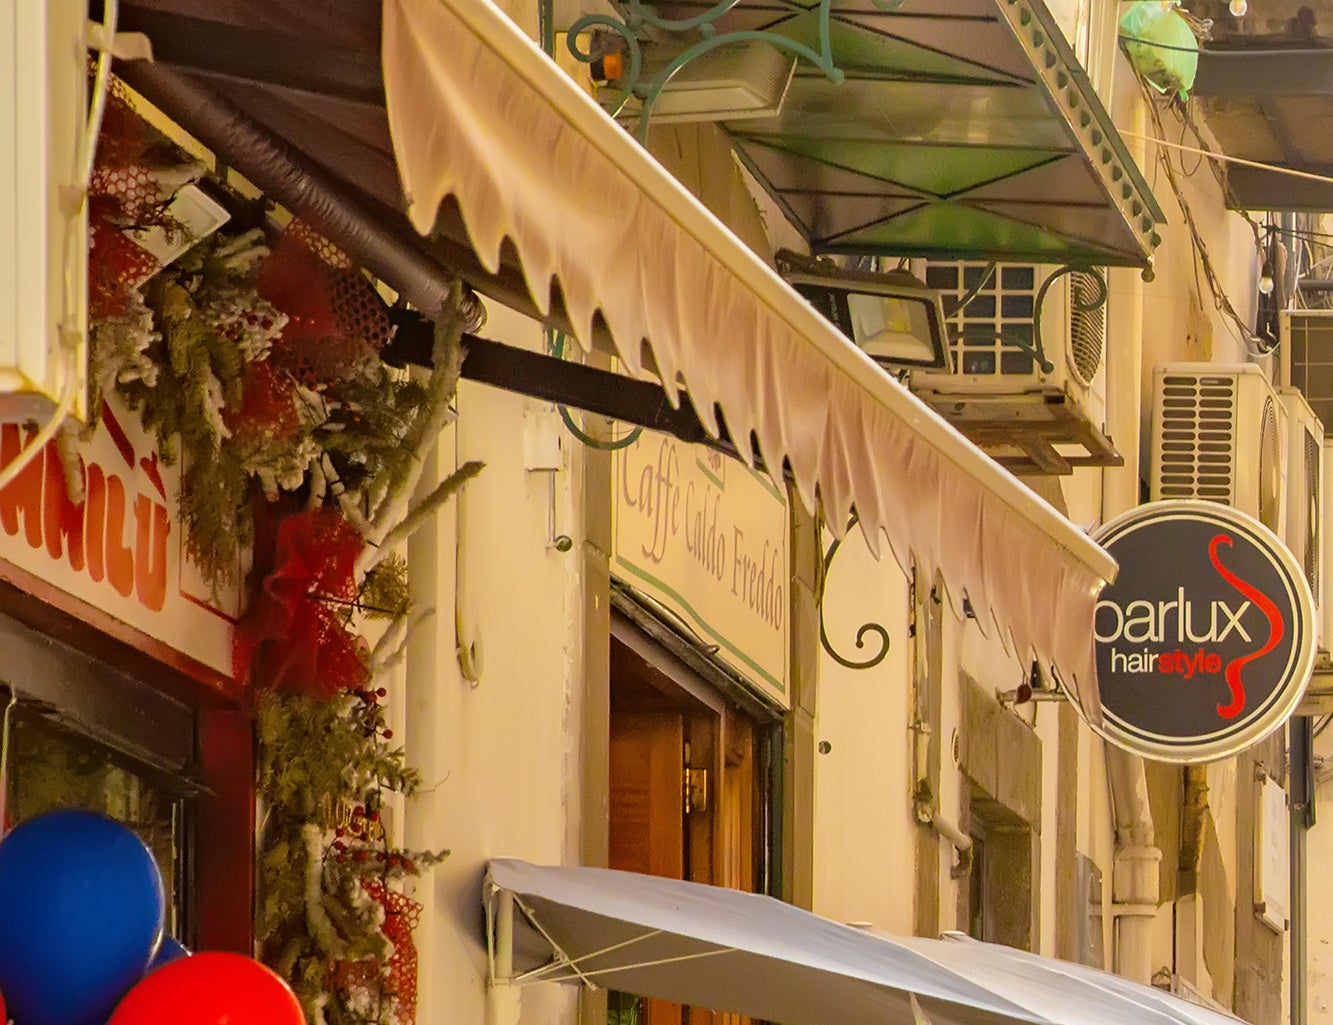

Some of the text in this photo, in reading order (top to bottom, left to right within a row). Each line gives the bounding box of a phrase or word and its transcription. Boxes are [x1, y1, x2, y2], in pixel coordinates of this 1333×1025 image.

[622, 437, 783, 631] Caffè Caldo Freddo
[1111, 647, 1222, 680] hairstyle
